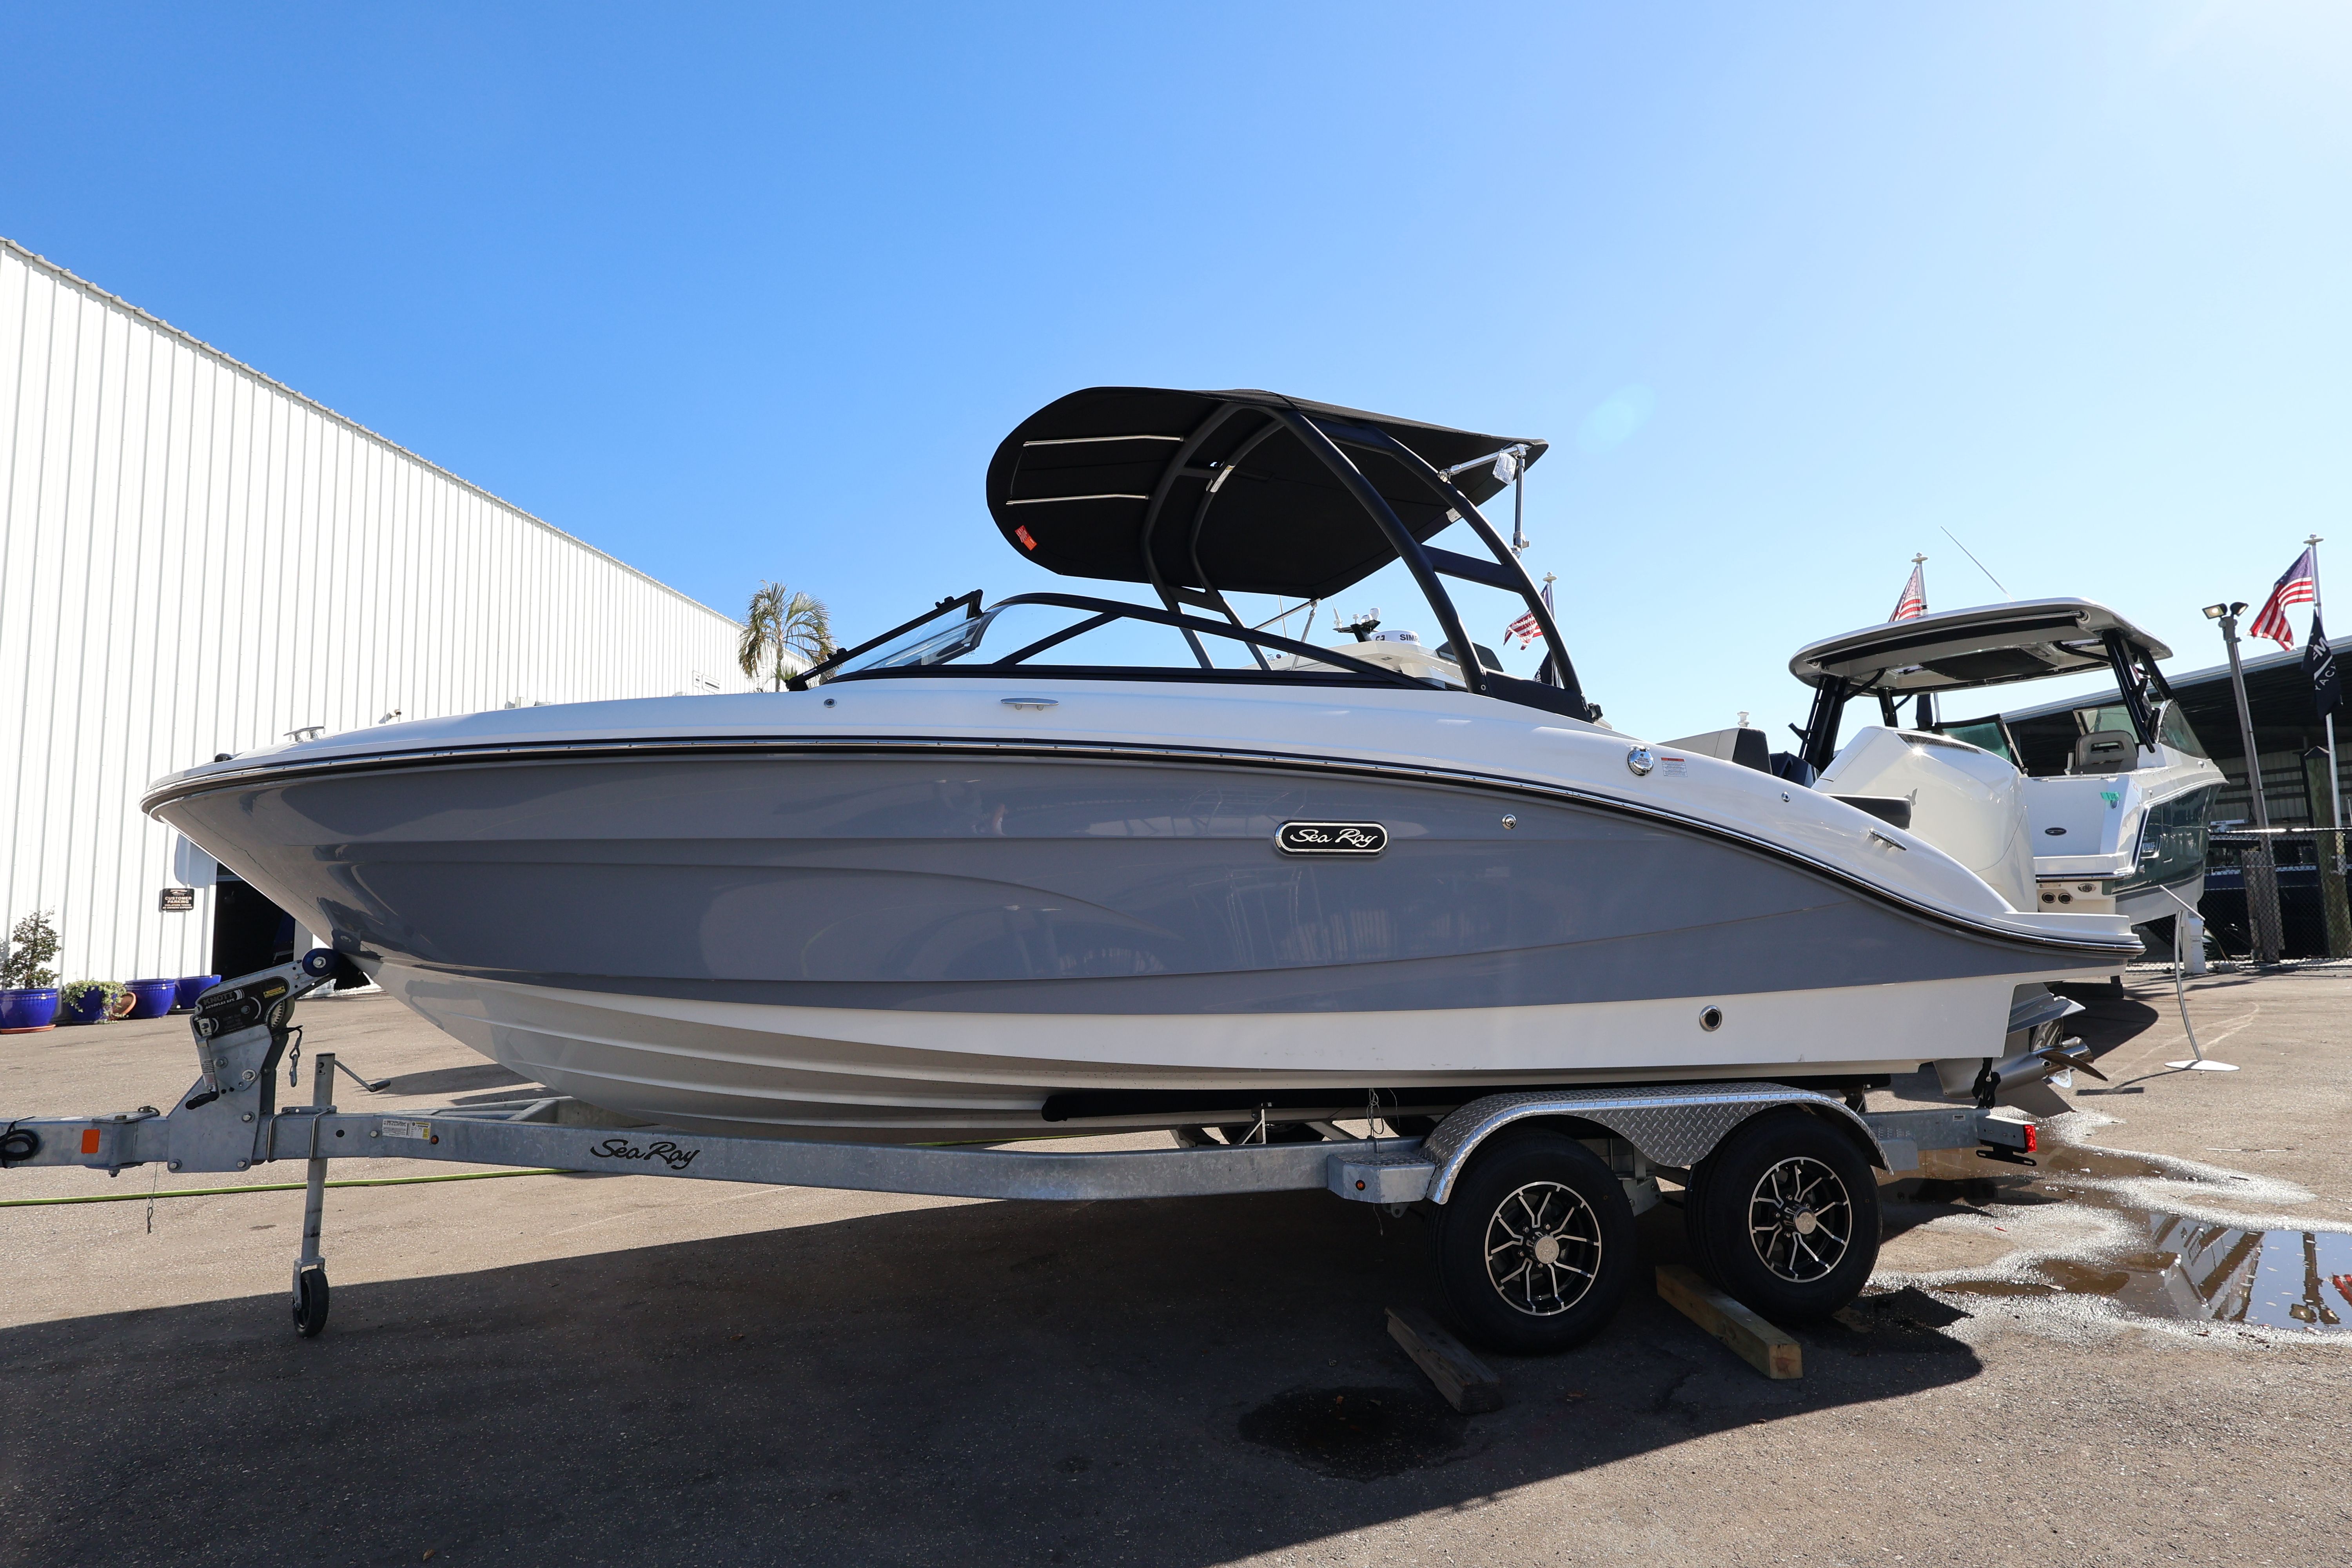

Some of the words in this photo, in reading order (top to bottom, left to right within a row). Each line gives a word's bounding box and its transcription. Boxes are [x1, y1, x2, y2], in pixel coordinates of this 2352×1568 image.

[1290, 829, 1333, 843] Sea
[1335, 828, 1378, 848] Ray
[203, 991, 233, 1005] KNOTT
[590, 1139, 646, 1160] Sea
[643, 1142, 700, 1170] Ray
